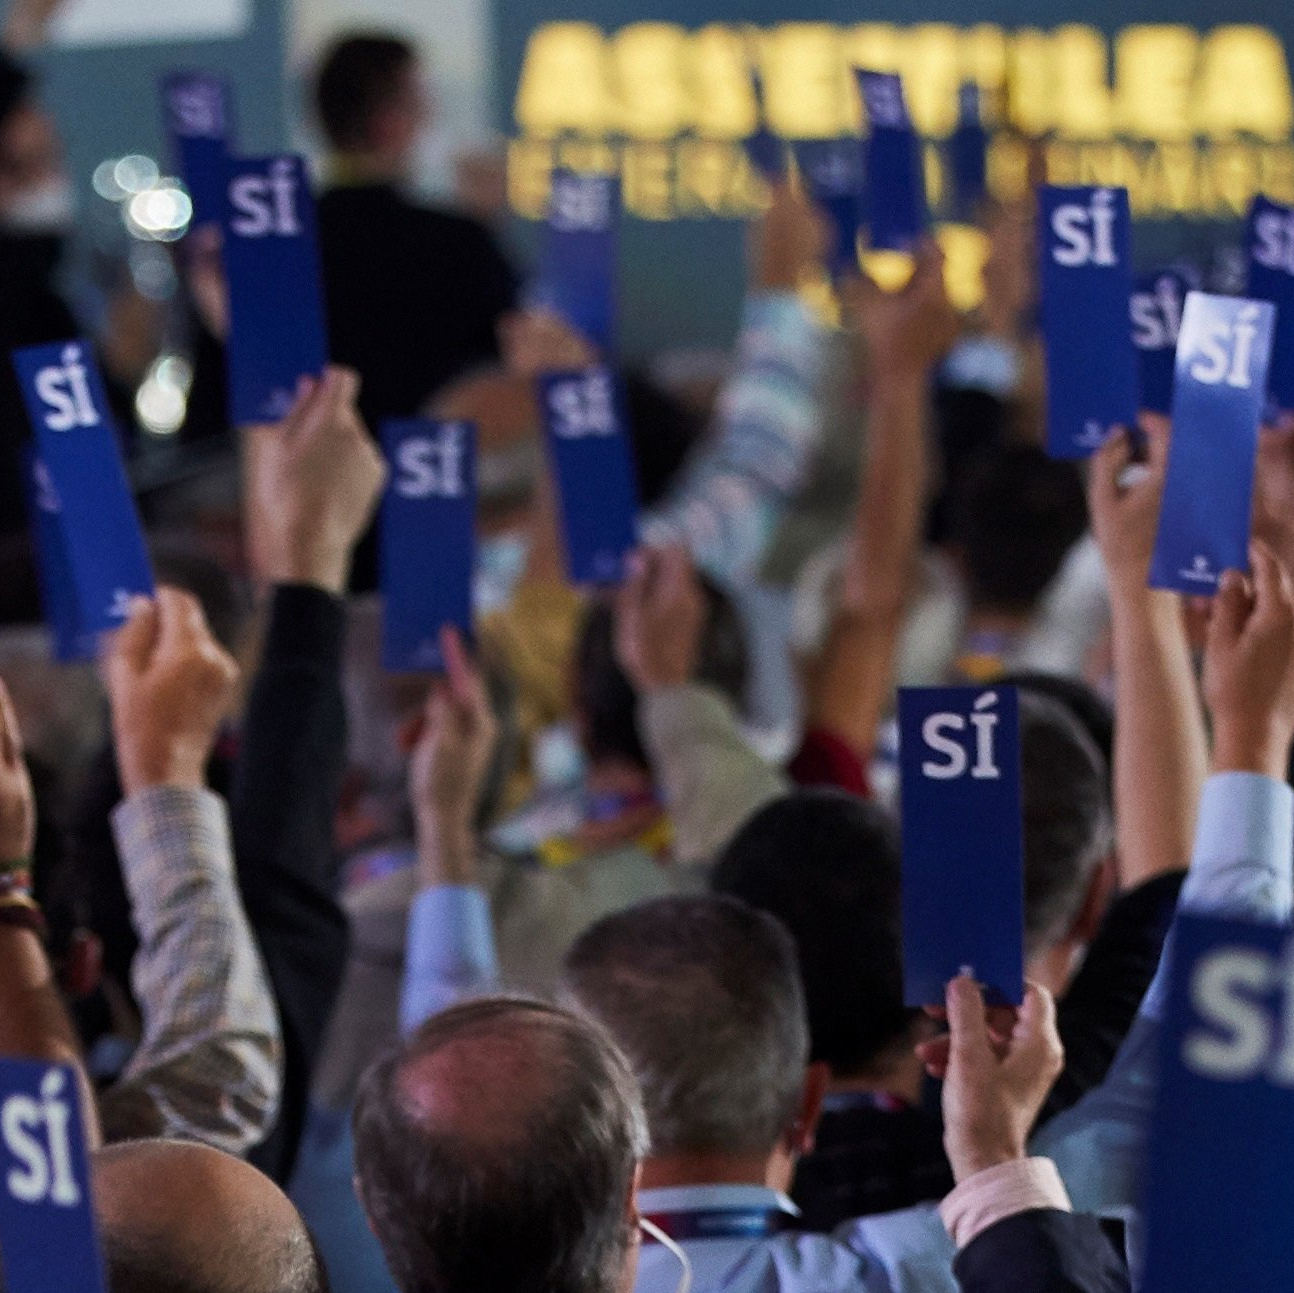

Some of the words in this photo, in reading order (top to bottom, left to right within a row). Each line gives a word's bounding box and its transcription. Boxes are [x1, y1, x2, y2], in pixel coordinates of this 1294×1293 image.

[228, 160, 305, 236] SÍ
[1052, 190, 1118, 267] SÍ
[1189, 305, 1261, 388] SÍ
[35, 344, 99, 431] SÍ
[549, 370, 617, 438] SÍ
[395, 423, 462, 497] SÍ
[921, 692, 999, 779] SÍ
[2, 1068, 80, 1206] SÍ
